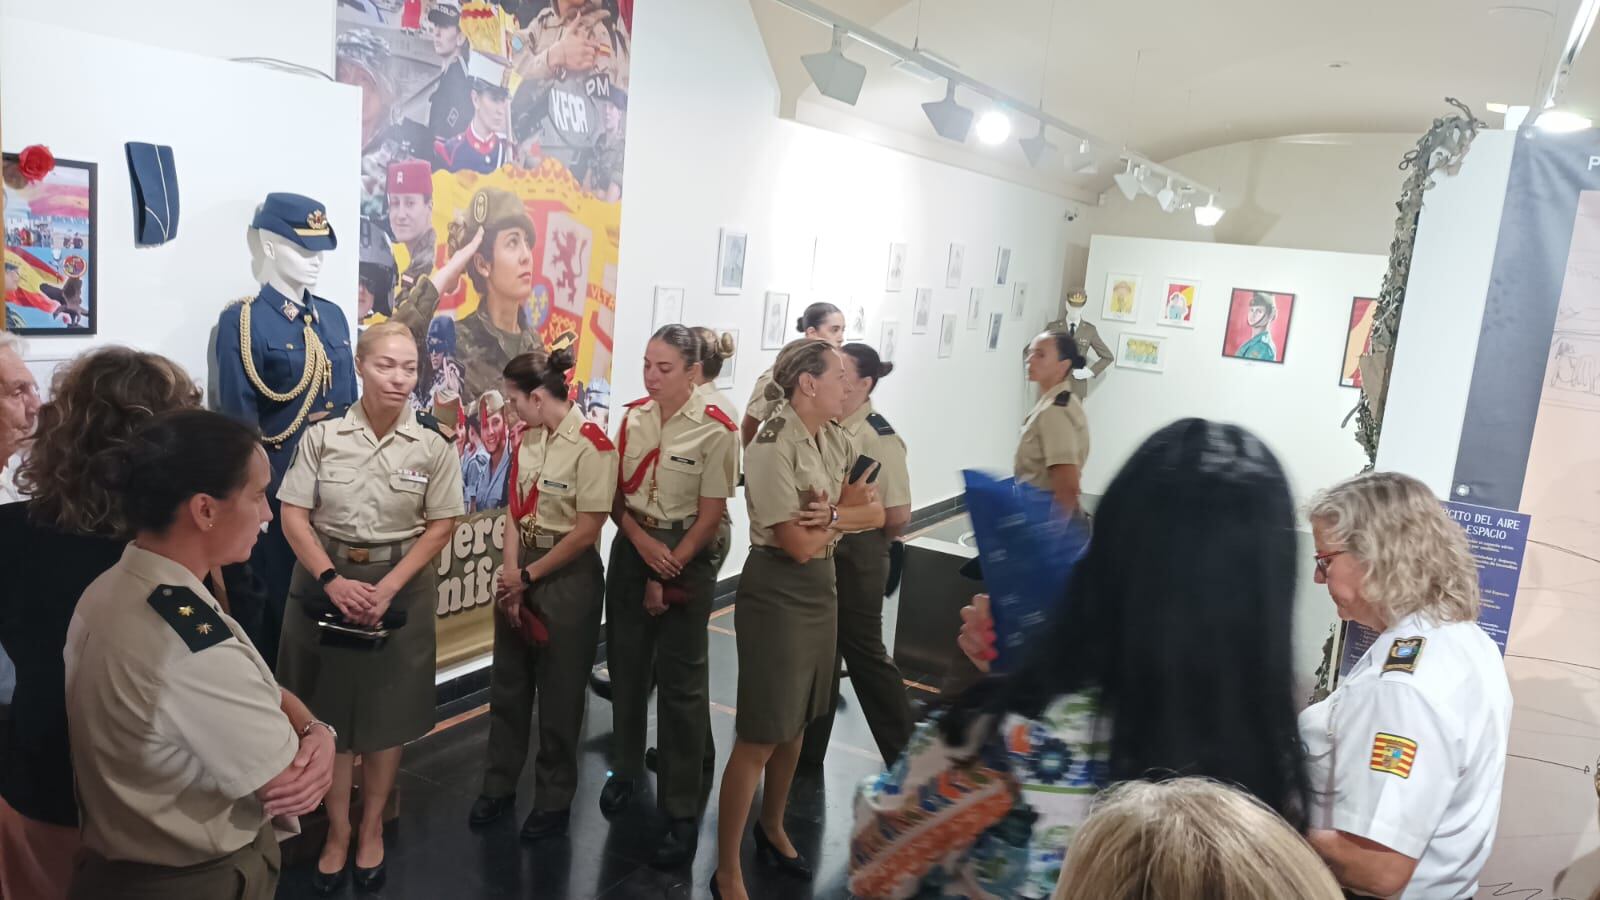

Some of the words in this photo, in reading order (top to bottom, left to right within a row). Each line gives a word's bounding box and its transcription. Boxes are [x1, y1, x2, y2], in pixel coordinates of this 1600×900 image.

[586, 75, 610, 97] PM
[551, 87, 589, 133] KFOR
[1465, 524, 1507, 540] ESPACIO
[1474, 513, 1493, 526] DEL
[1496, 518, 1521, 531] AIRE
